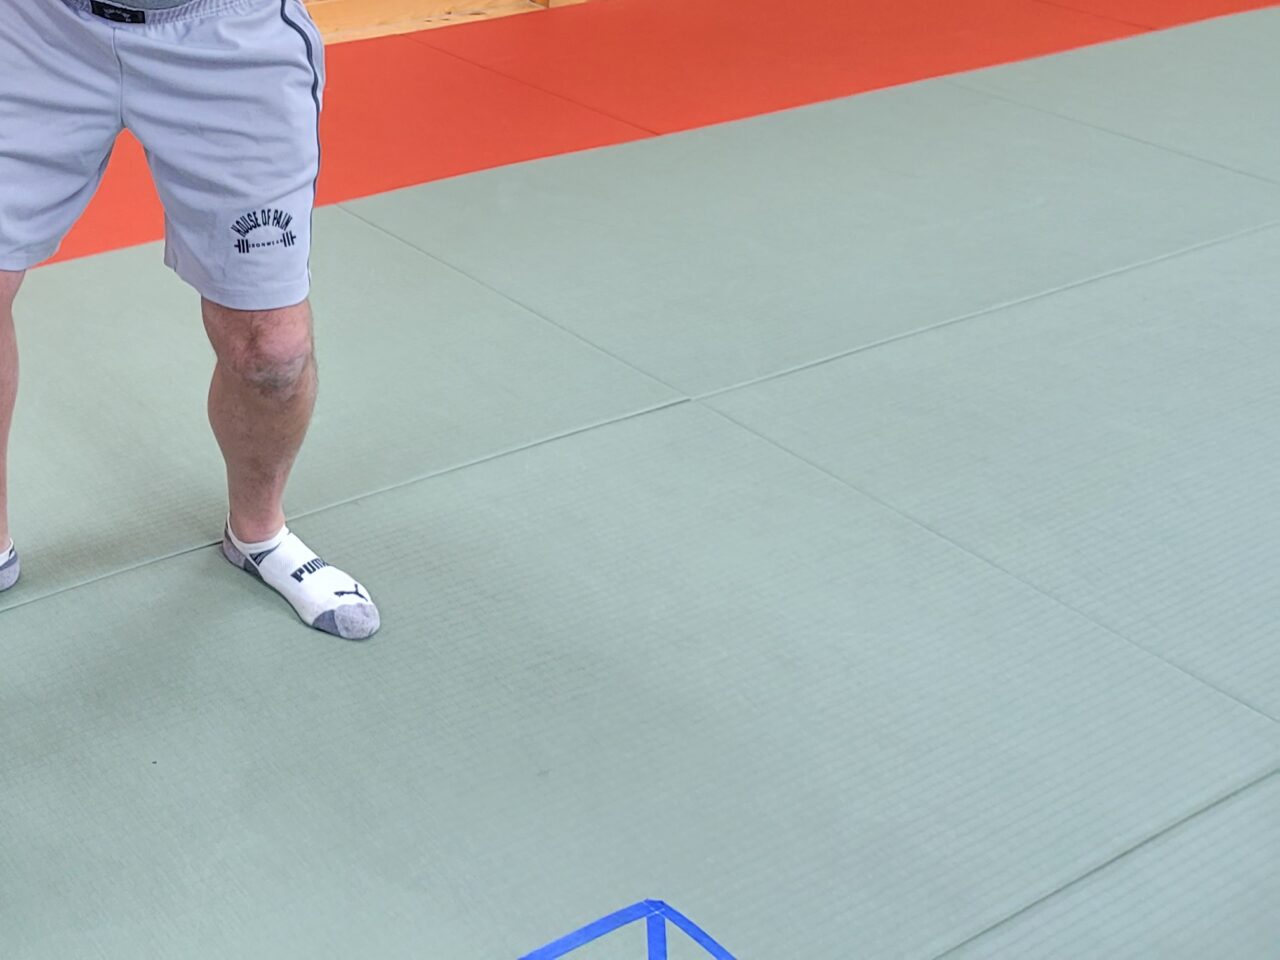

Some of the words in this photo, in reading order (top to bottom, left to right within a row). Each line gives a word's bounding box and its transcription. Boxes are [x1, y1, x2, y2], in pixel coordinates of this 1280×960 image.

[230, 211, 261, 238] HOUSE
[261, 208, 271, 226] OF
[272, 209, 293, 231] PAIN
